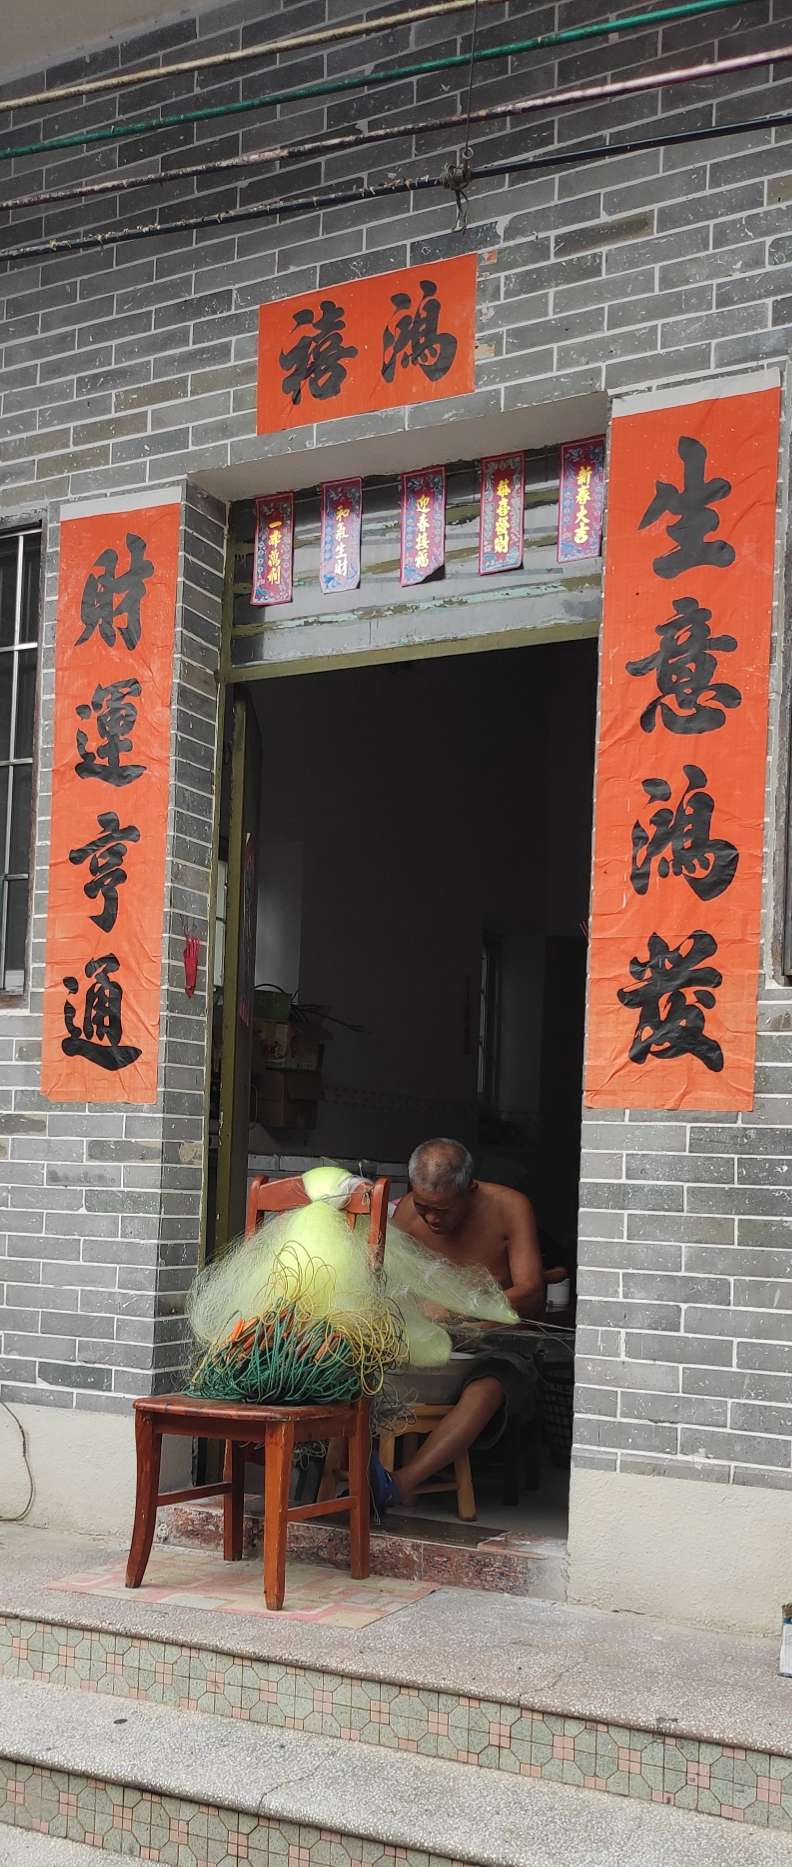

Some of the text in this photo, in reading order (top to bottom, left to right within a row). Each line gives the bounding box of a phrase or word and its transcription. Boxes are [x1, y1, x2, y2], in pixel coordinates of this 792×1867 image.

[334, 505, 350, 577] 和氣生財
[415, 494, 431, 569] 迎春接福
[574, 465, 593, 544] 新春大吉
[616, 435, 743, 1073] 生意鴻發
[61, 532, 155, 1072] 財運亨通
